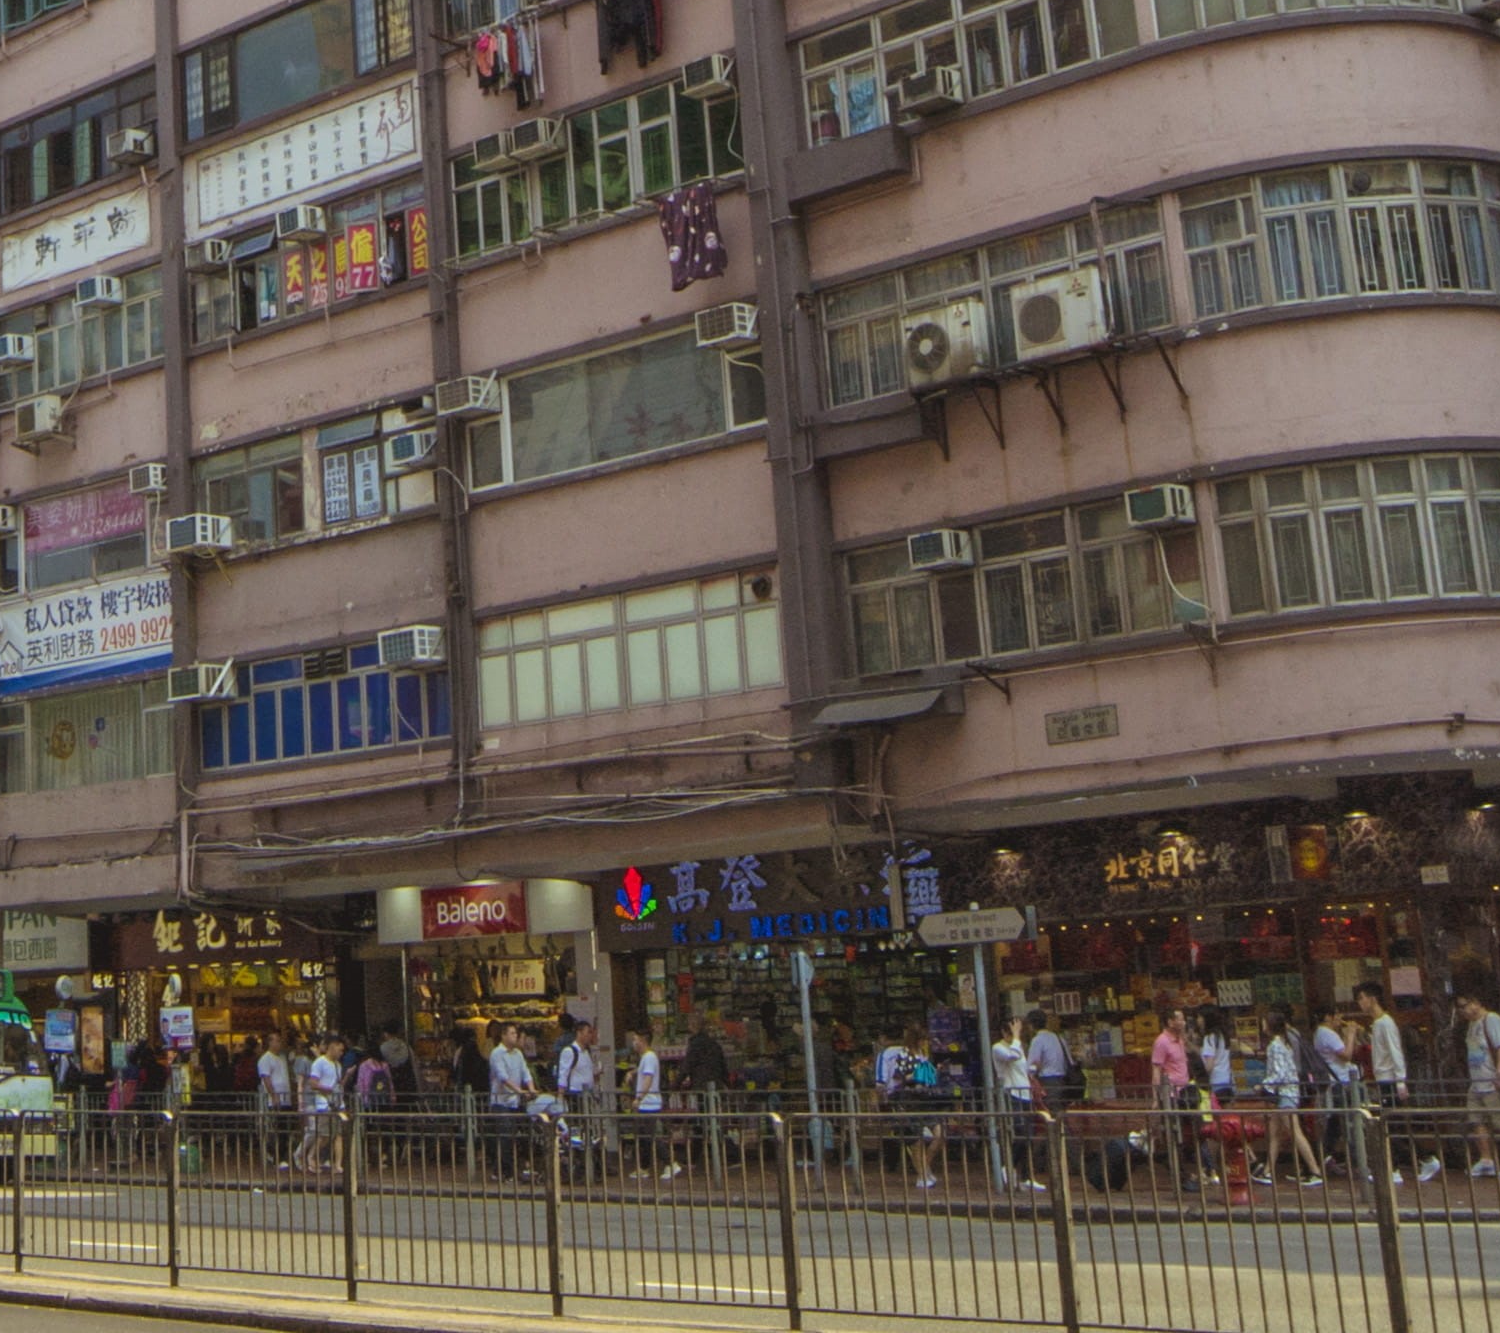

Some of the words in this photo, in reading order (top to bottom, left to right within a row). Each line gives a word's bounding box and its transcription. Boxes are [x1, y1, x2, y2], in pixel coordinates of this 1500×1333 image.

[24, 596, 94, 633] 私人貸款
[26, 629, 95, 666] 英利財務
[101, 622, 137, 653] 2499
[437, 895, 506, 926] Baleno
[750, 905, 892, 939] MEDICIN
